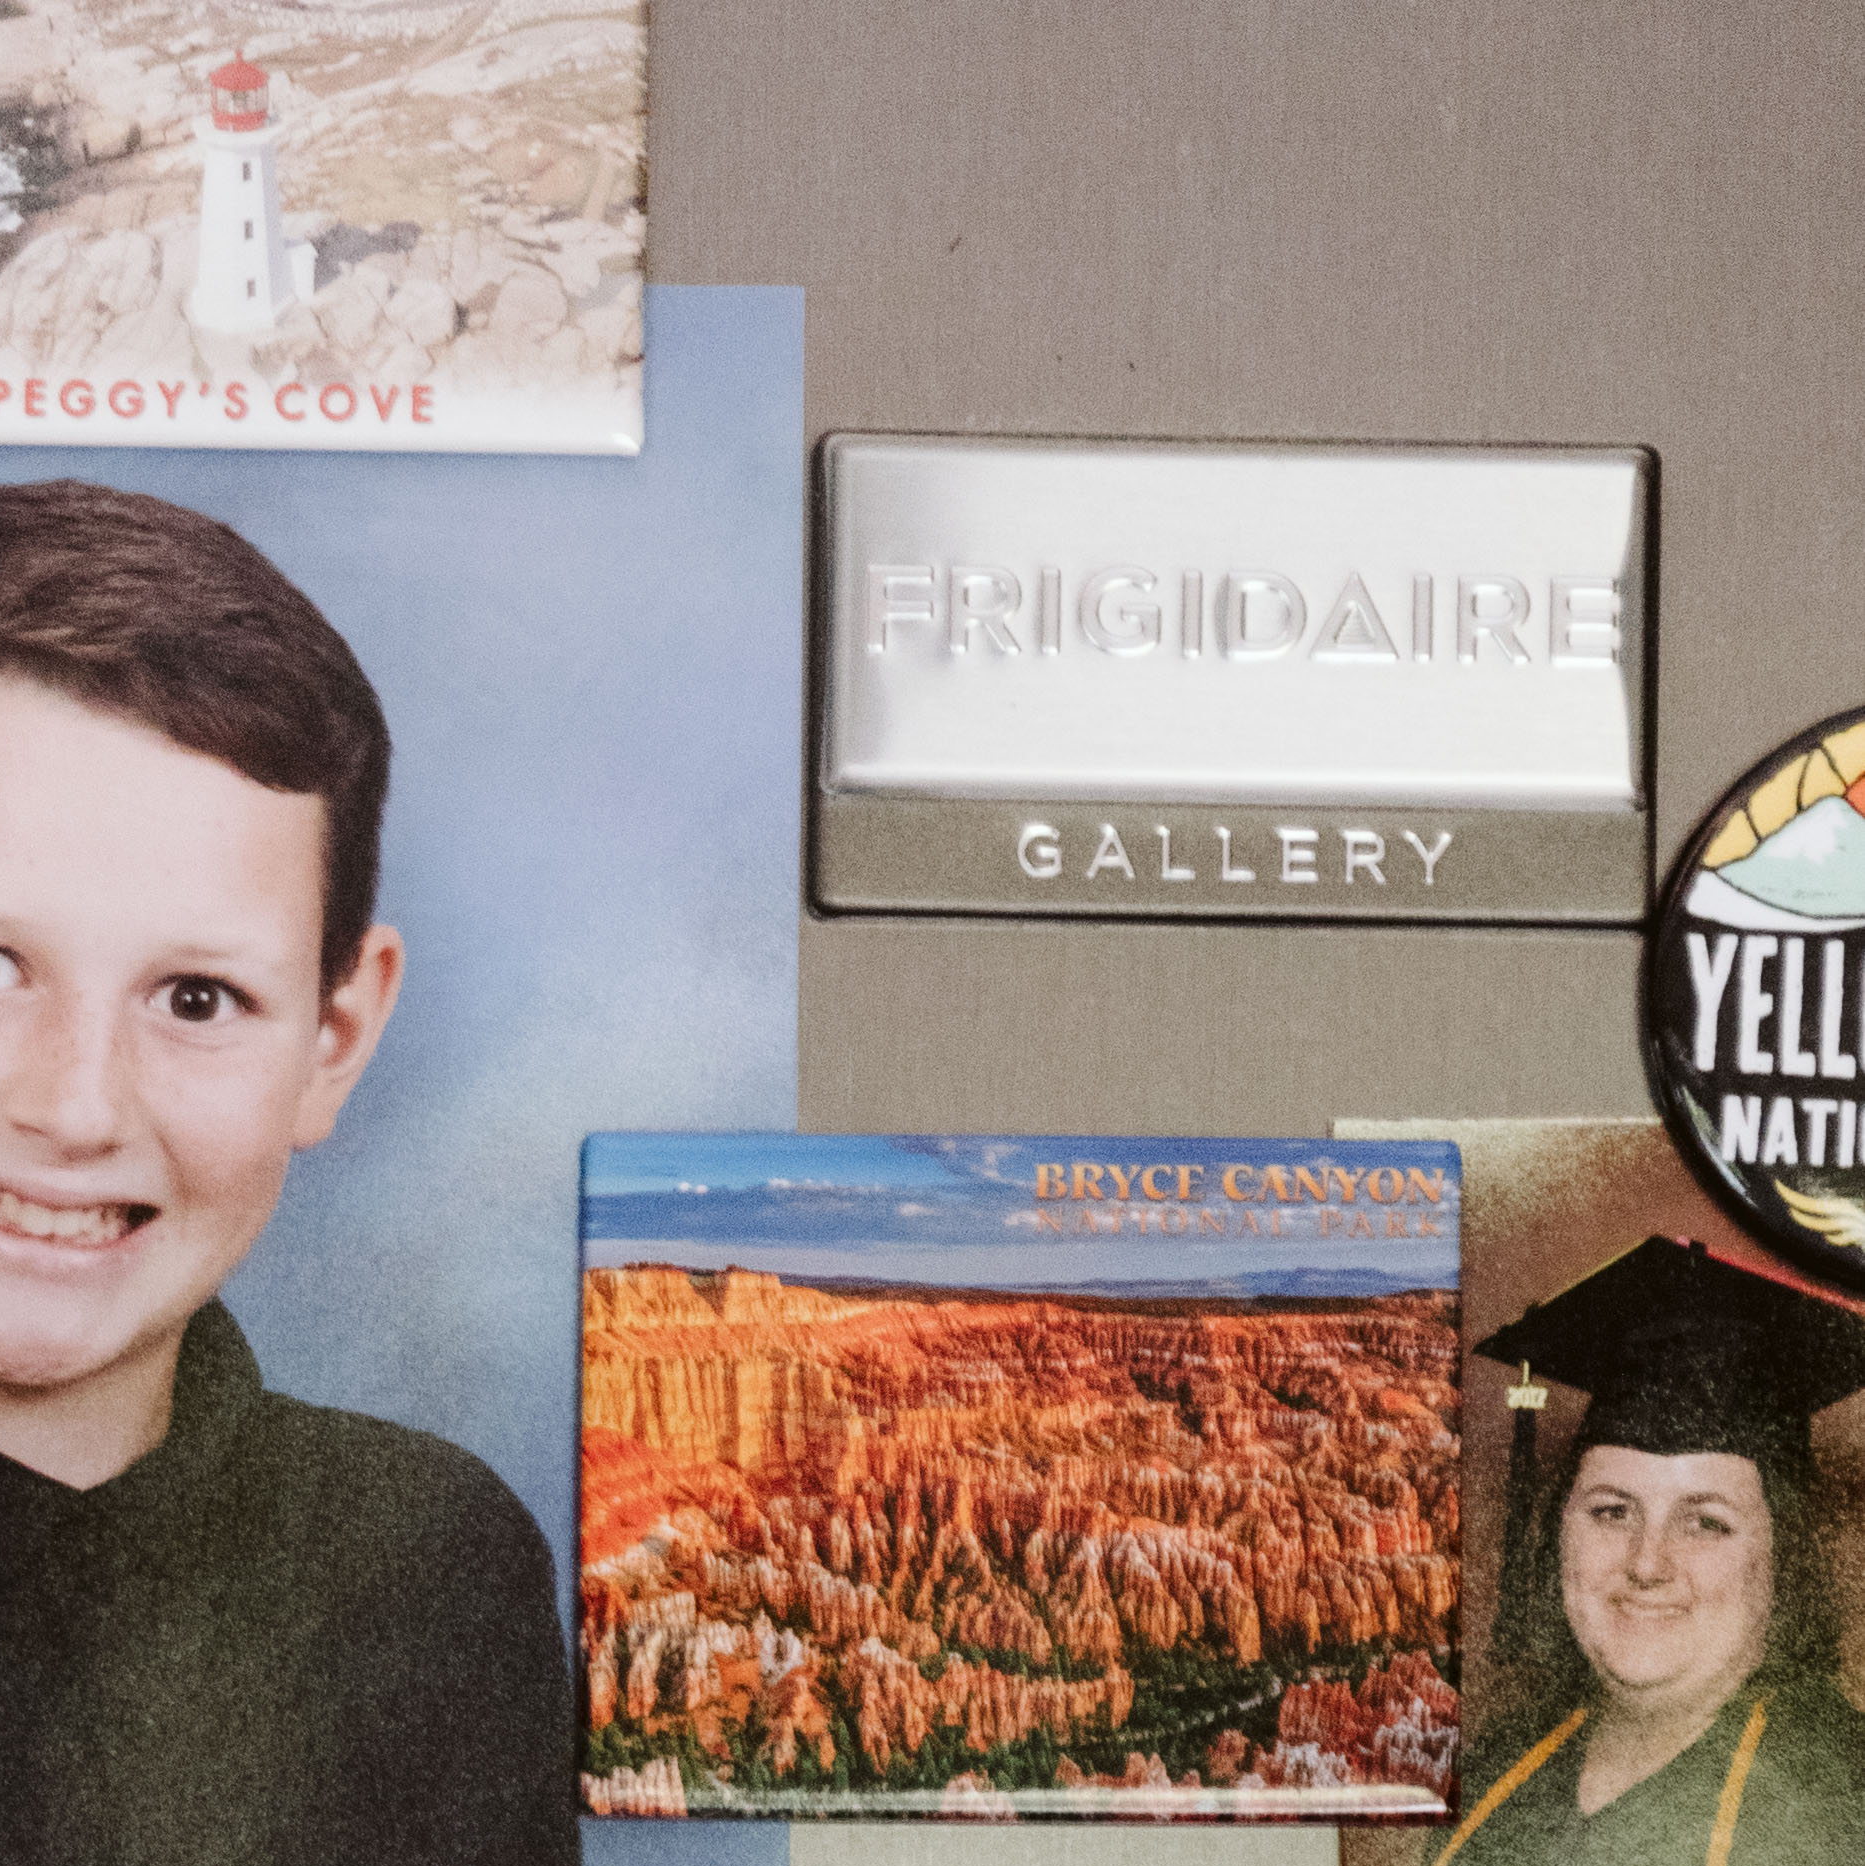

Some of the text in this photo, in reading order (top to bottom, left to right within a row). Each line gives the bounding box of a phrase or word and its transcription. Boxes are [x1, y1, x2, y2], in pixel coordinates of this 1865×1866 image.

[274, 382, 435, 424] COVE
[864, 563, 1622, 670] FRIGIDAIRE
[1015, 824, 1454, 886] GALLERY
[1685, 932, 1865, 1078] YELL
[1721, 1094, 1865, 1168] NATI
[1036, 1162, 1446, 1206] BRYCE CANYON
[1037, 1206, 1444, 1240] NATIONAL PARK
